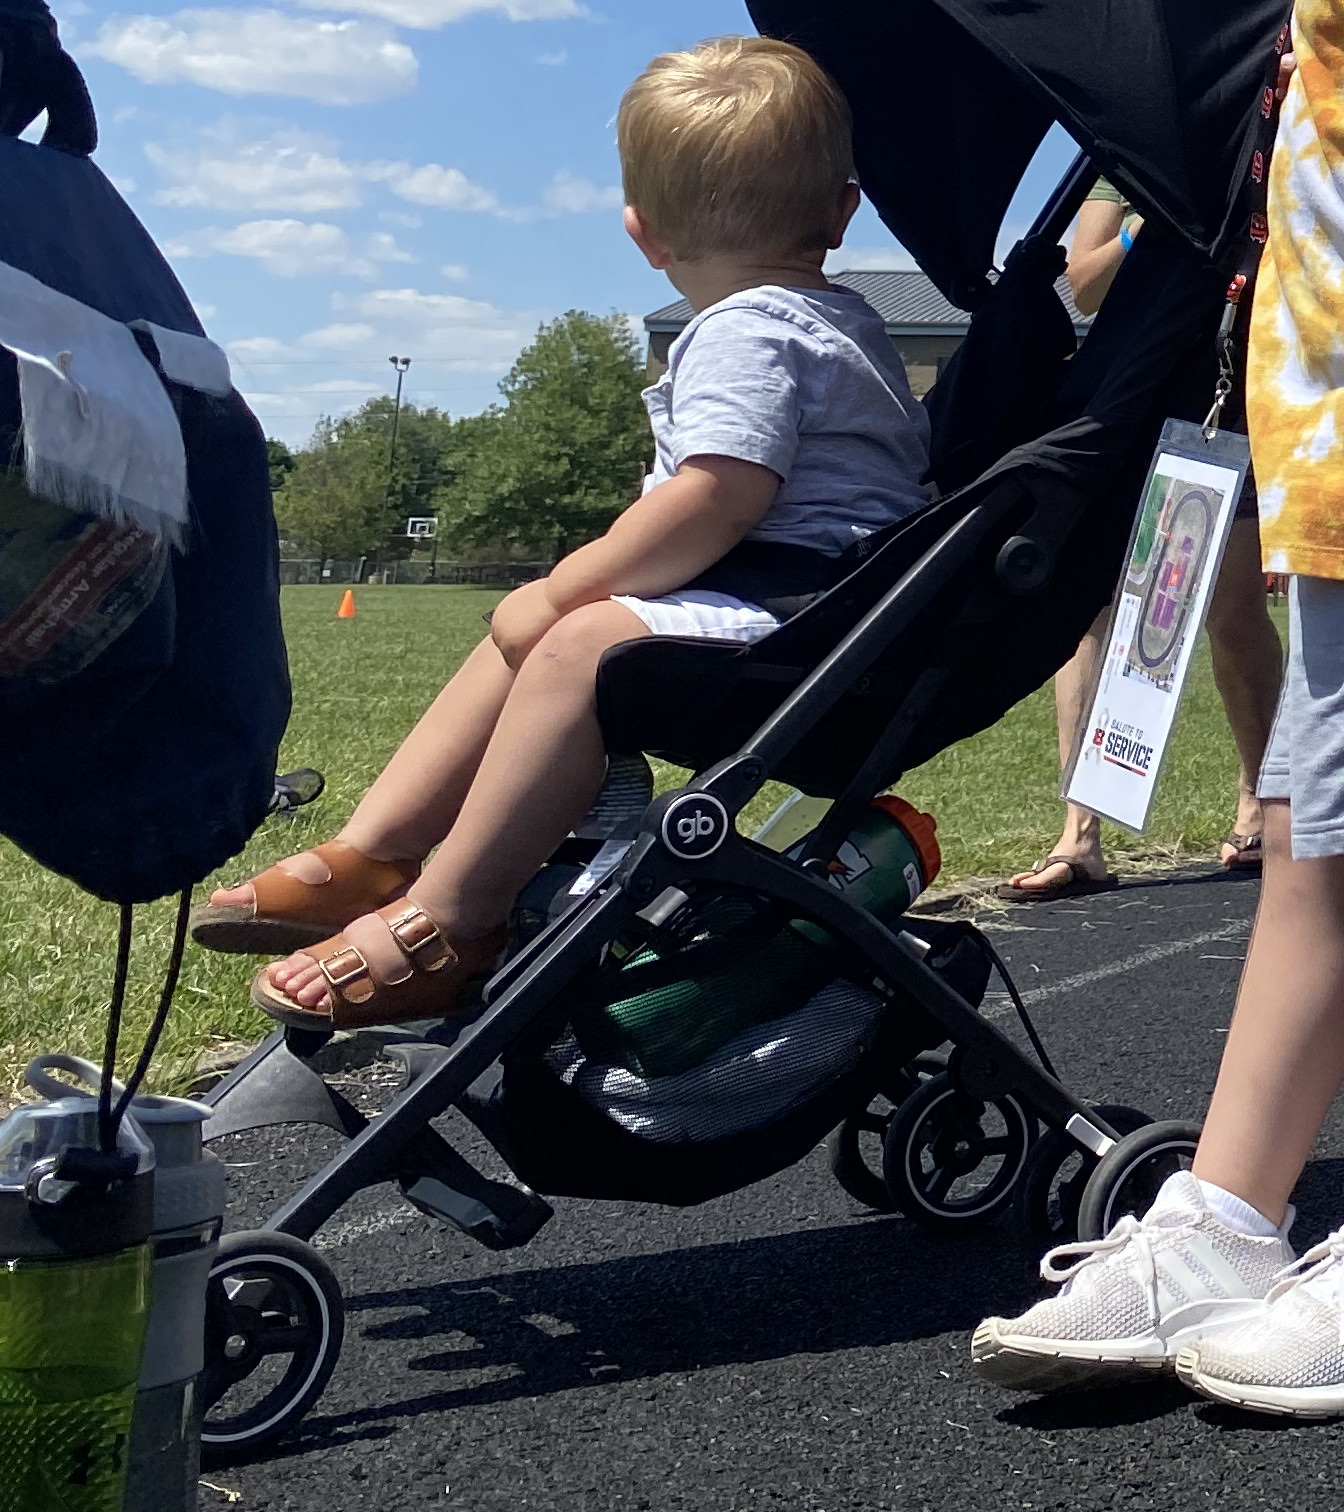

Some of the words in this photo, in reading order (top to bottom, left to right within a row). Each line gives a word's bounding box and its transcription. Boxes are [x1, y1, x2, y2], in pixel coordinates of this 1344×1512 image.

[25, 579, 91, 647] Armchair
[1110, 719, 1135, 737] SALUTE
[1135, 728, 1144, 740] TO
[1104, 731, 1154, 770] SERVICE
[677, 810, 715, 844] gb
